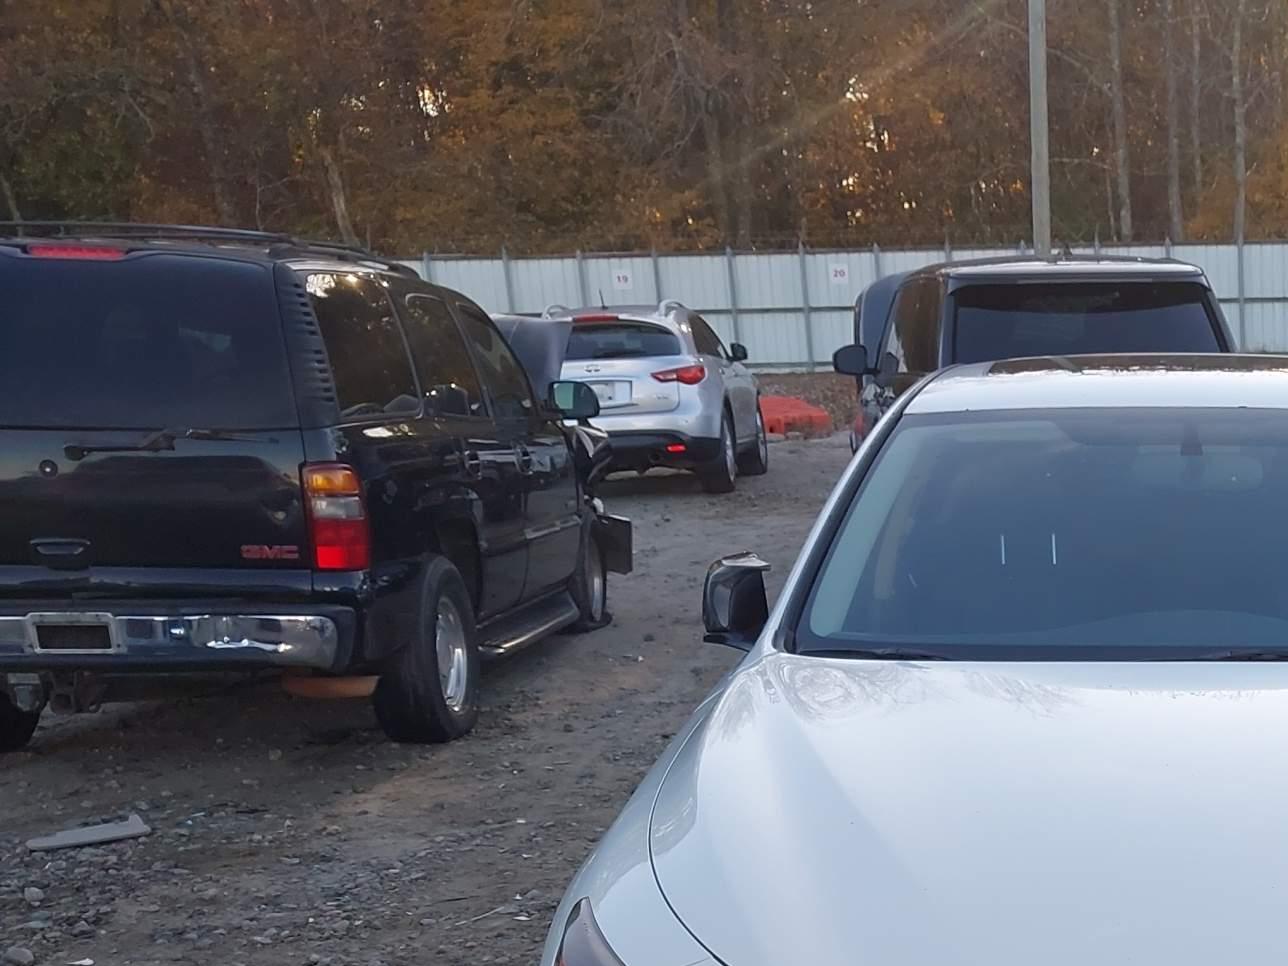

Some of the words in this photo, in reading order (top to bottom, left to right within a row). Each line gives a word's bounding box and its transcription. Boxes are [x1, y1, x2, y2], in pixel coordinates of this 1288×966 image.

[832, 269, 846, 278] 20
[617, 274, 628, 284] 19
[240, 545, 300, 559] GMC
